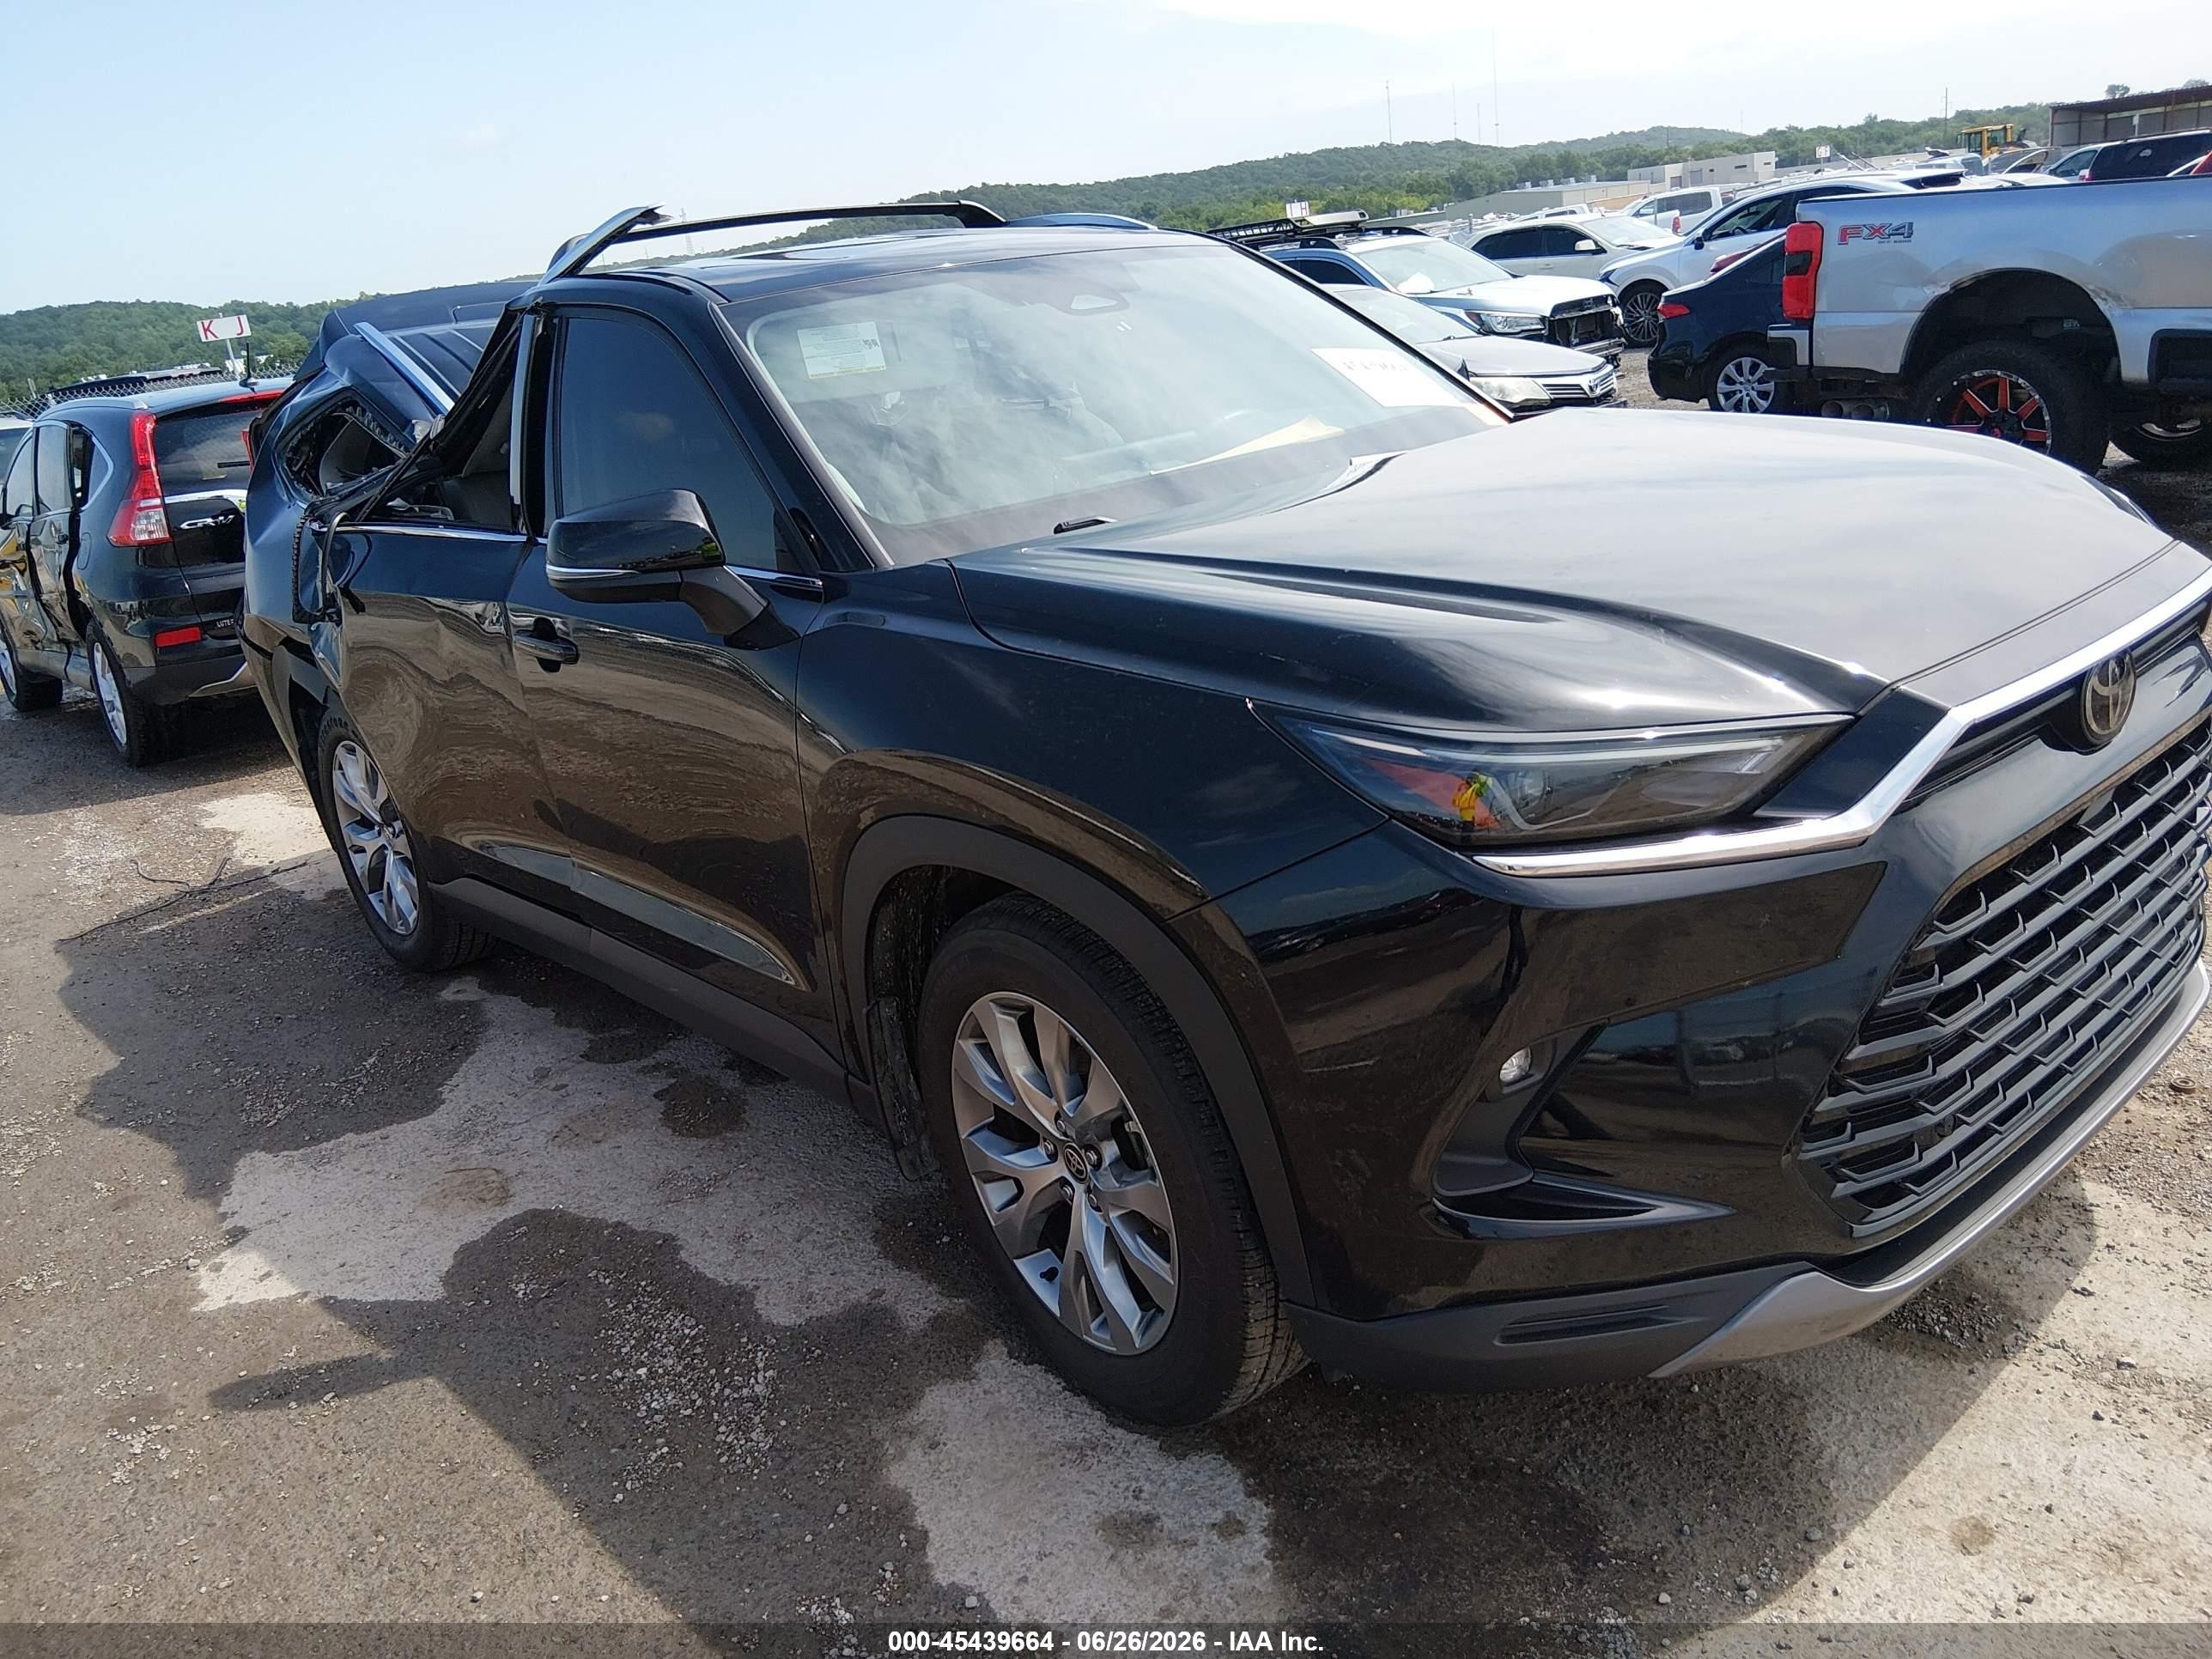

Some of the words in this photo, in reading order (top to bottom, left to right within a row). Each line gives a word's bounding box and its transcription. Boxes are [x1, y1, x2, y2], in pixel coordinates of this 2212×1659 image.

[1299, 202, 1308, 216] H
[1837, 222, 1914, 246] FX4
[200, 319, 220, 340] K
[236, 316, 244, 336] J
